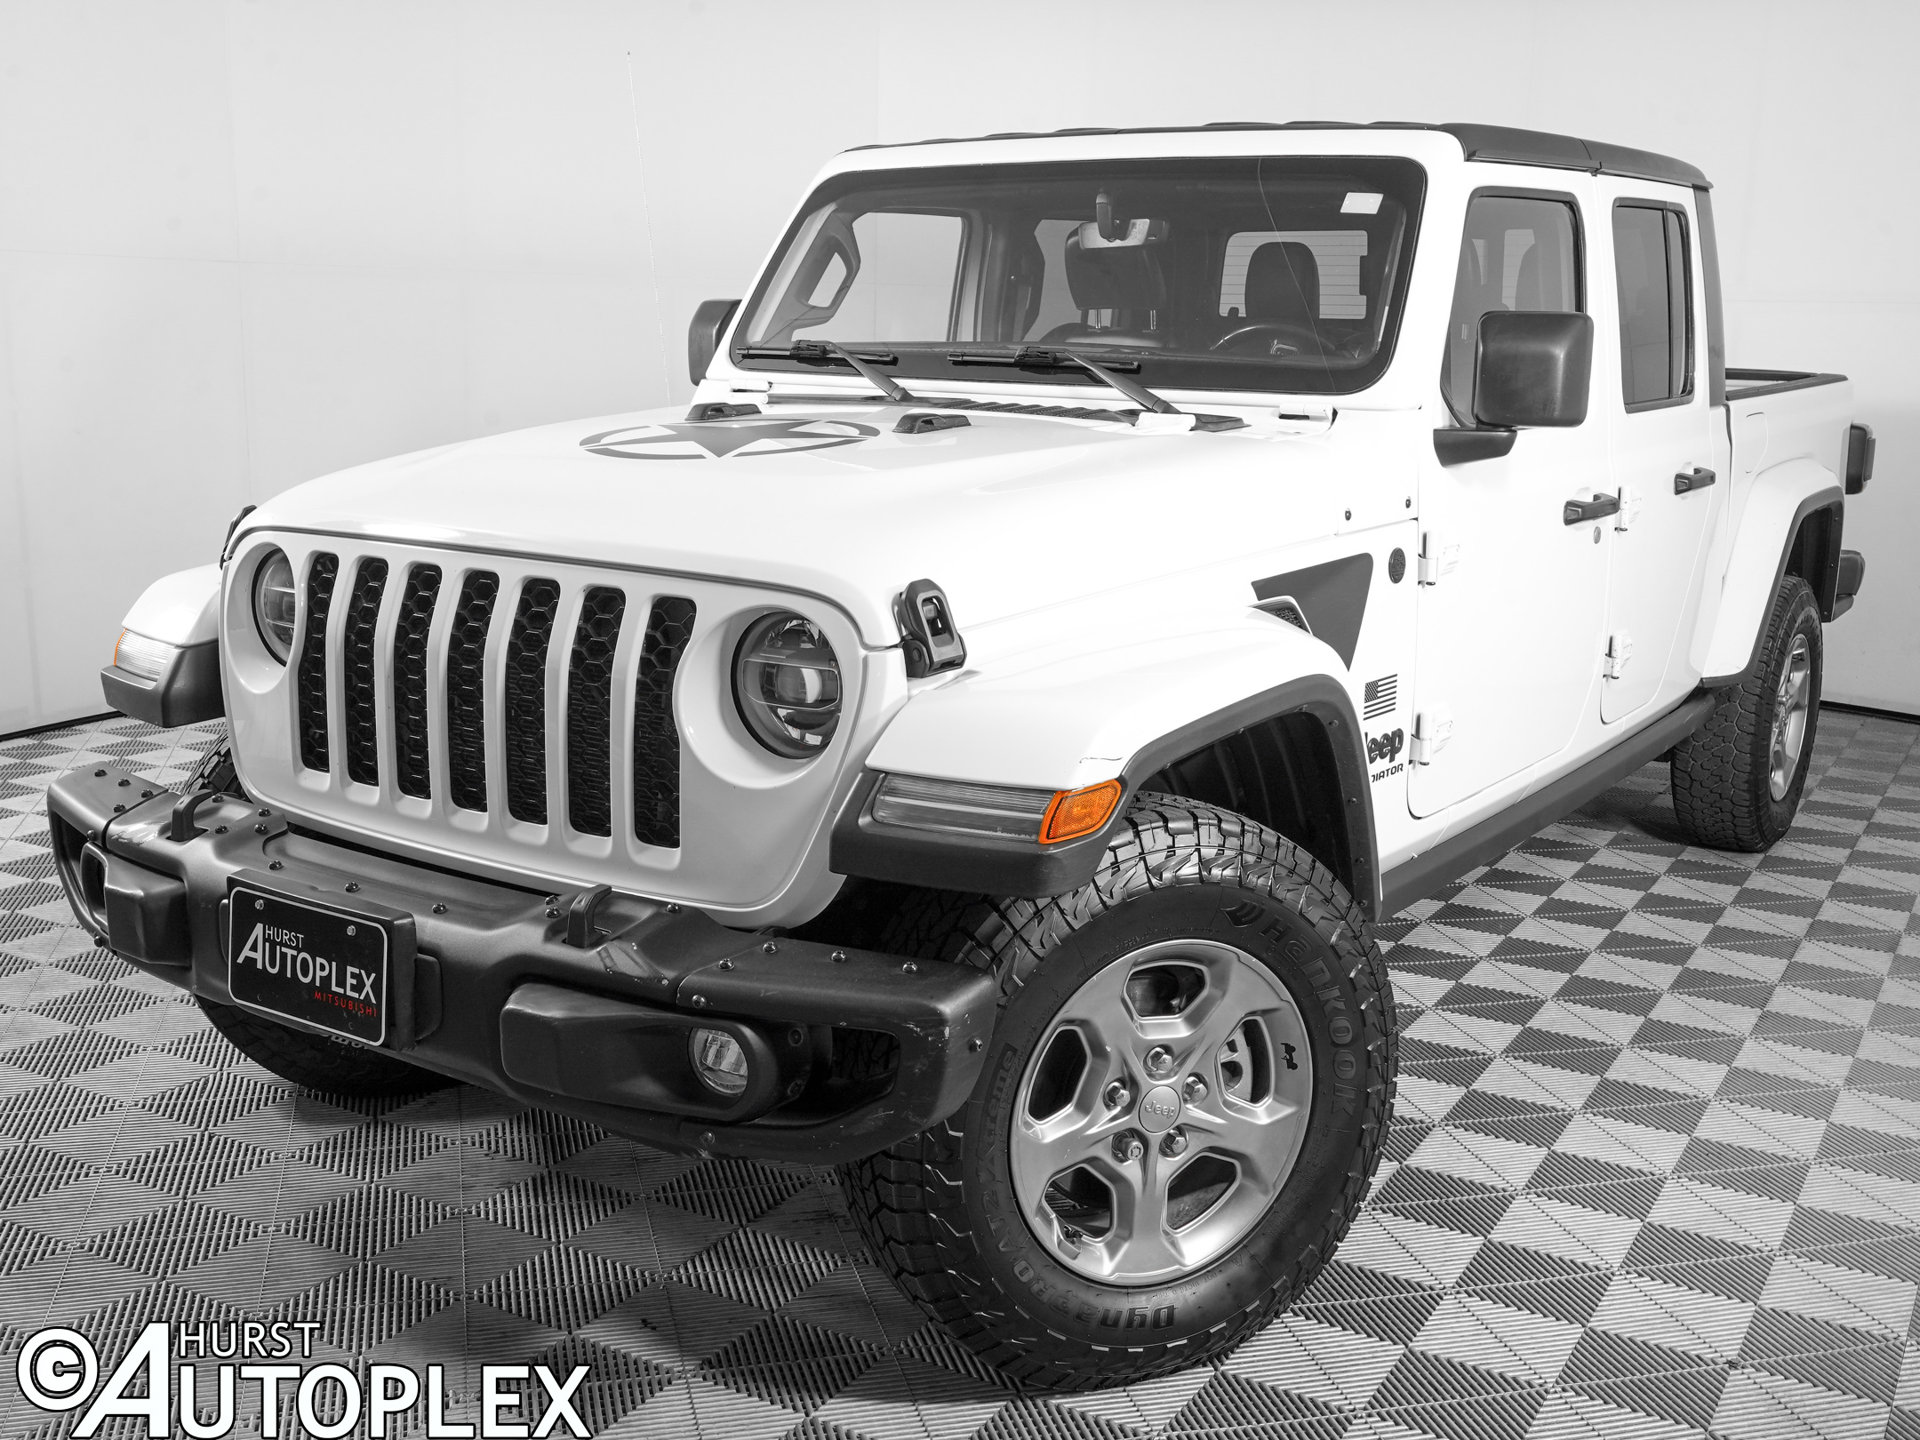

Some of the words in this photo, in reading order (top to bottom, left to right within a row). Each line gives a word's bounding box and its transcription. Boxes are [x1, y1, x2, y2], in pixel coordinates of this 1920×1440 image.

[1364, 728, 1404, 764] eep
[265, 924, 304, 948] HURST
[236, 922, 377, 1004] AUTOPLEX
[314, 991, 377, 1017] MITSUBISHI
[1145, 1100, 1175, 1119] Jeep
